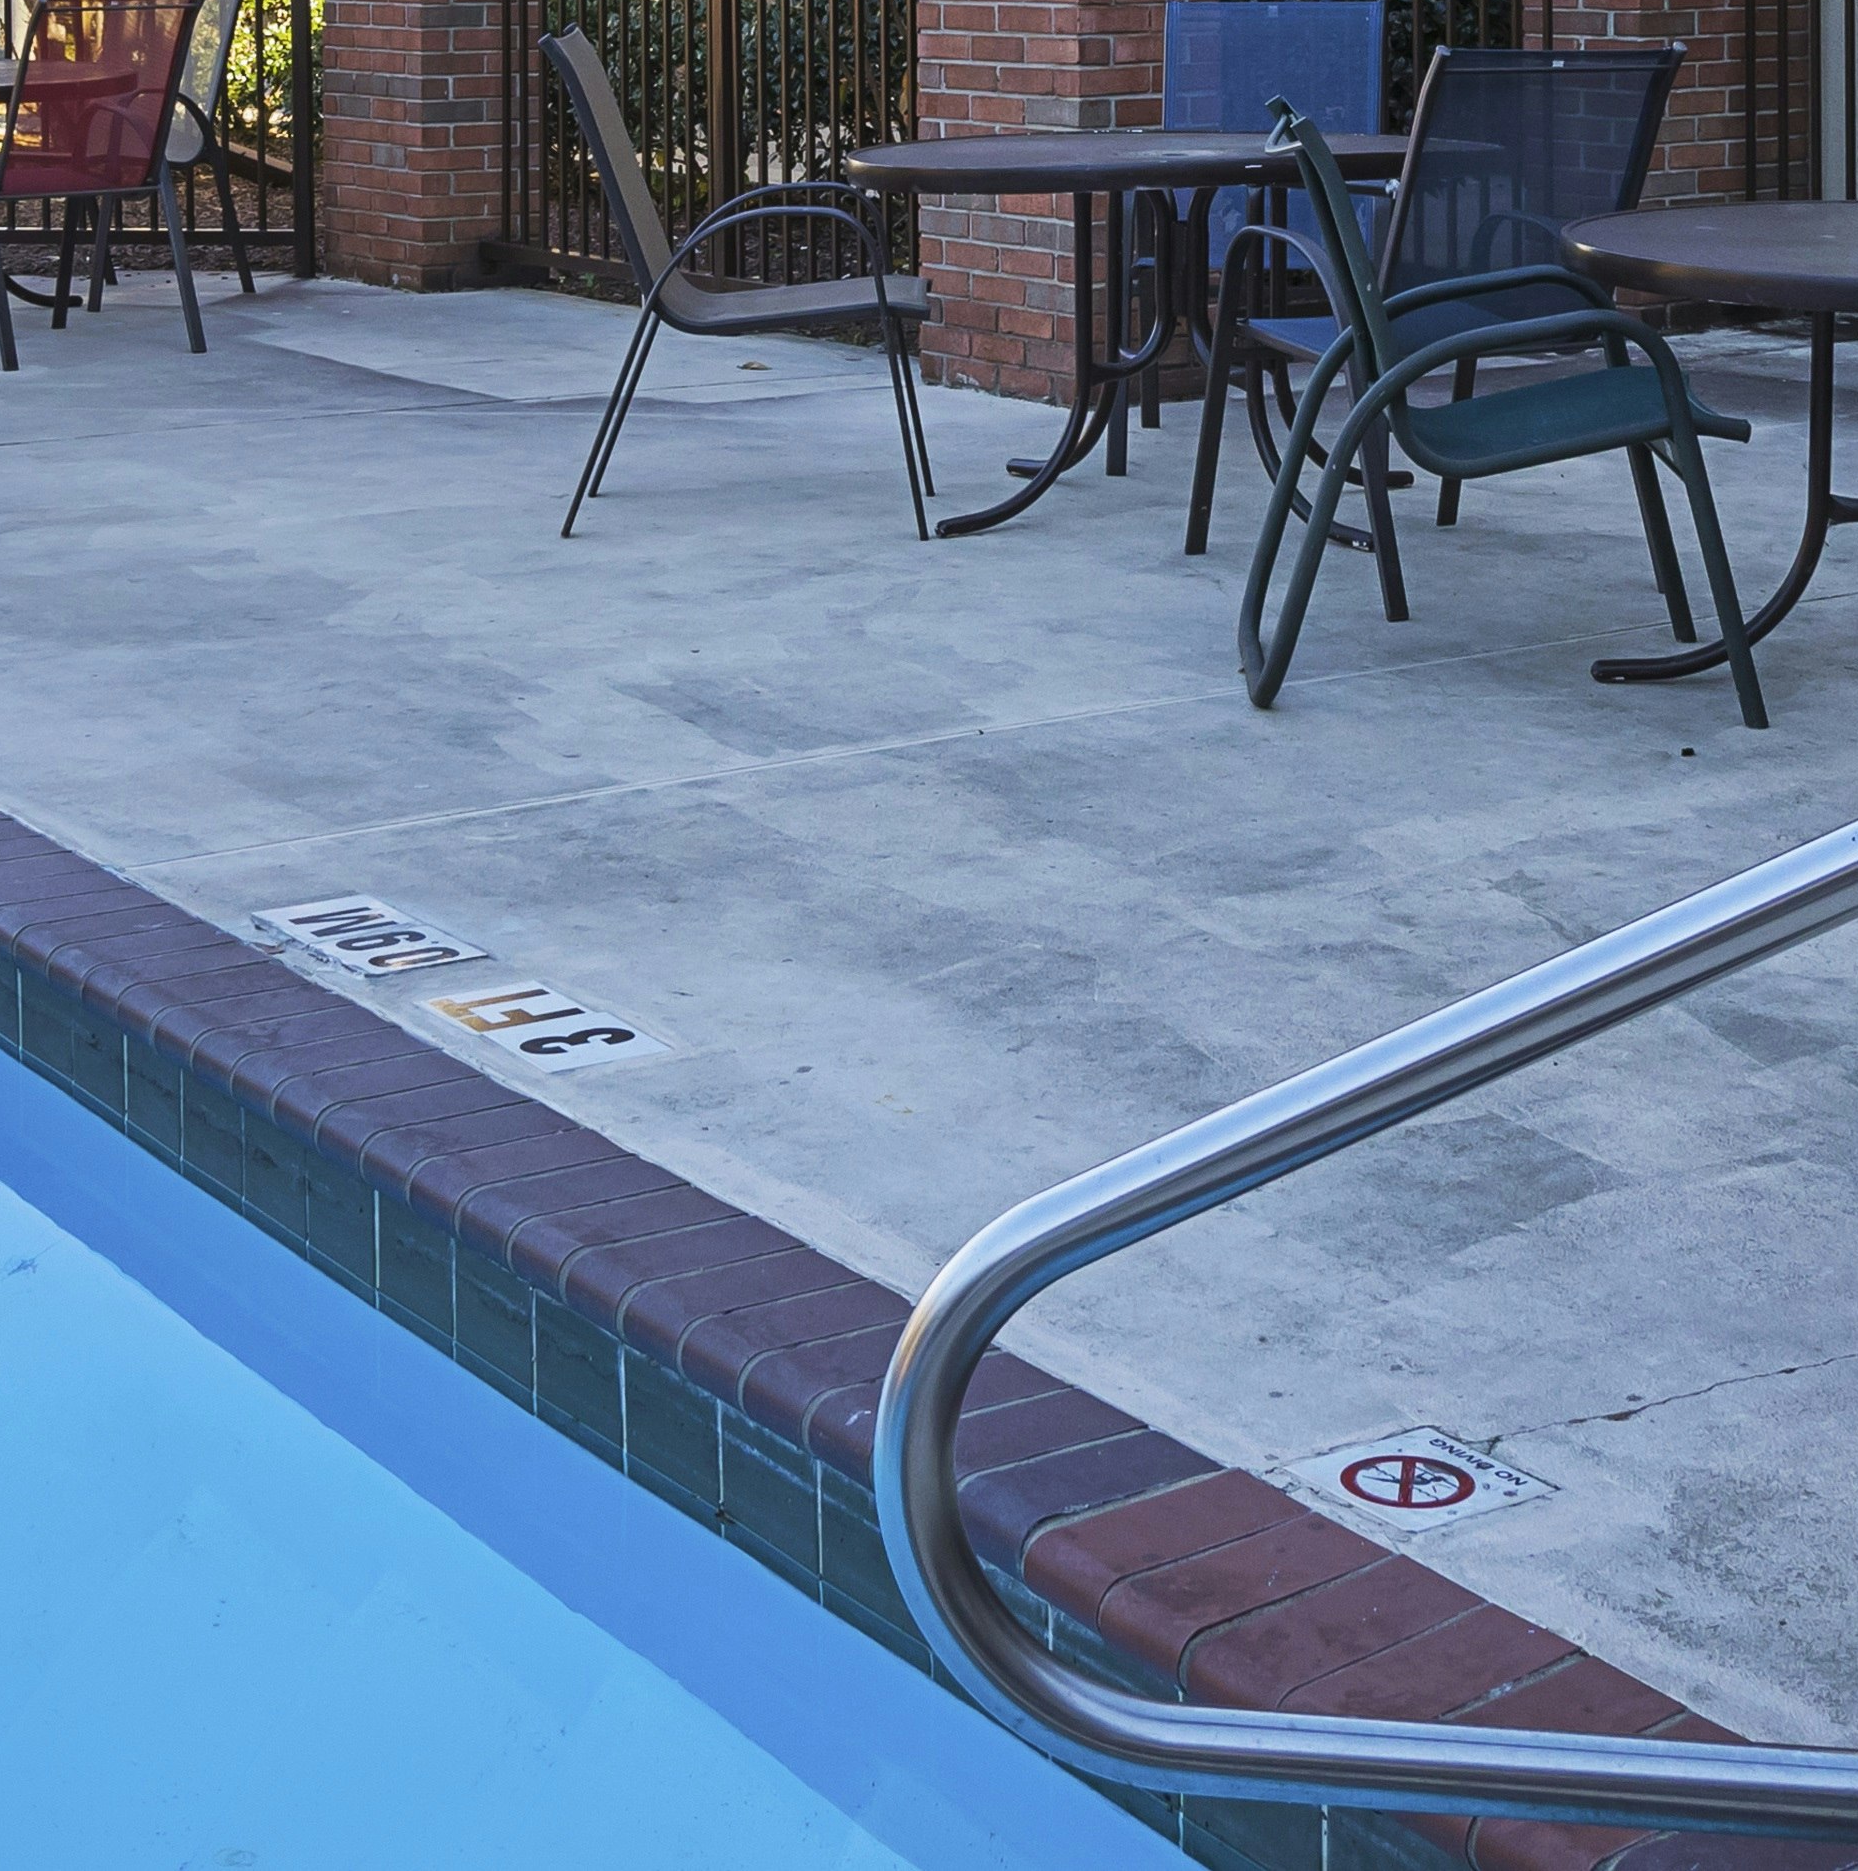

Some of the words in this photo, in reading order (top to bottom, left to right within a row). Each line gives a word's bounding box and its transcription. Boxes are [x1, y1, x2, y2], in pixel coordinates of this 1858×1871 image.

[428, 988, 586, 1034] FT
[518, 1027, 636, 1055] 3
[1428, 1437, 1496, 1471] DIVING
[1494, 1470, 1529, 1487] NO
